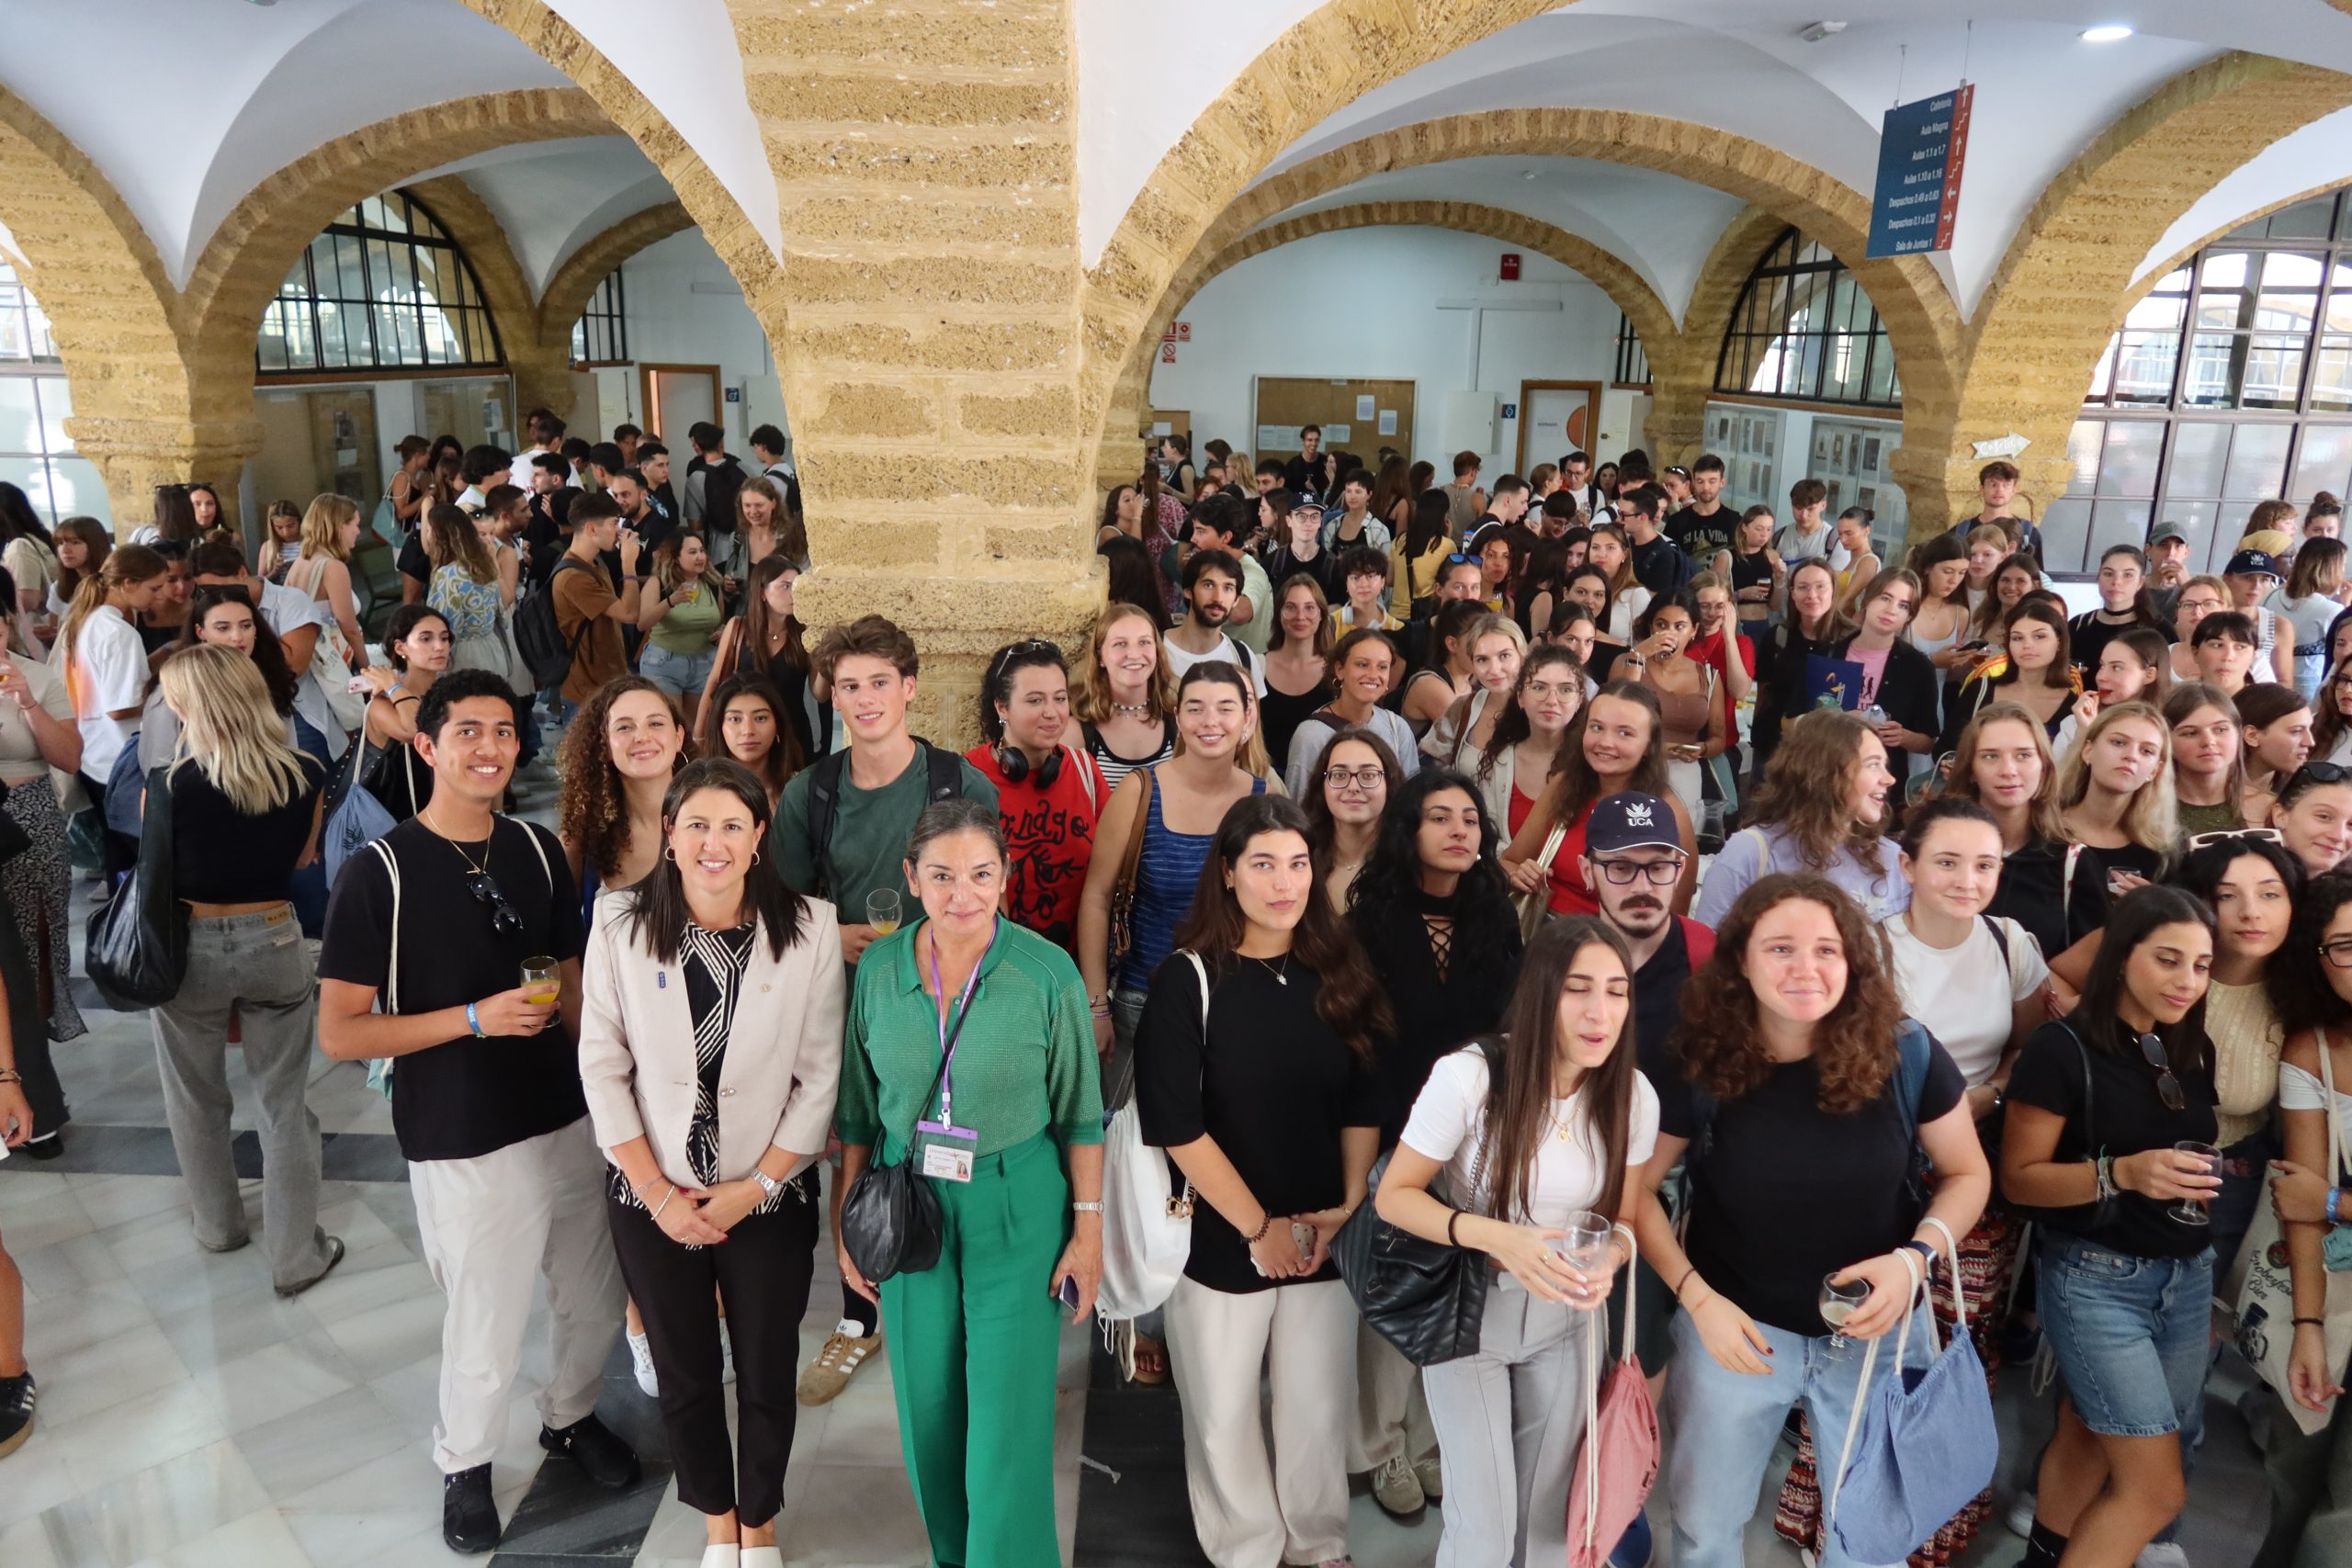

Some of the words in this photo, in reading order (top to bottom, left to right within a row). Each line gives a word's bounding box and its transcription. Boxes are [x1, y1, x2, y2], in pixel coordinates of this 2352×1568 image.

[1920, 125, 1932, 135] Aula
[1888, 195, 1915, 209] Despachos
[1888, 217, 1914, 230] Despachos
[1895, 241, 1906, 252] Sala
[1708, 528, 1728, 543] VIDA
[1627, 818, 1654, 828] UCA
